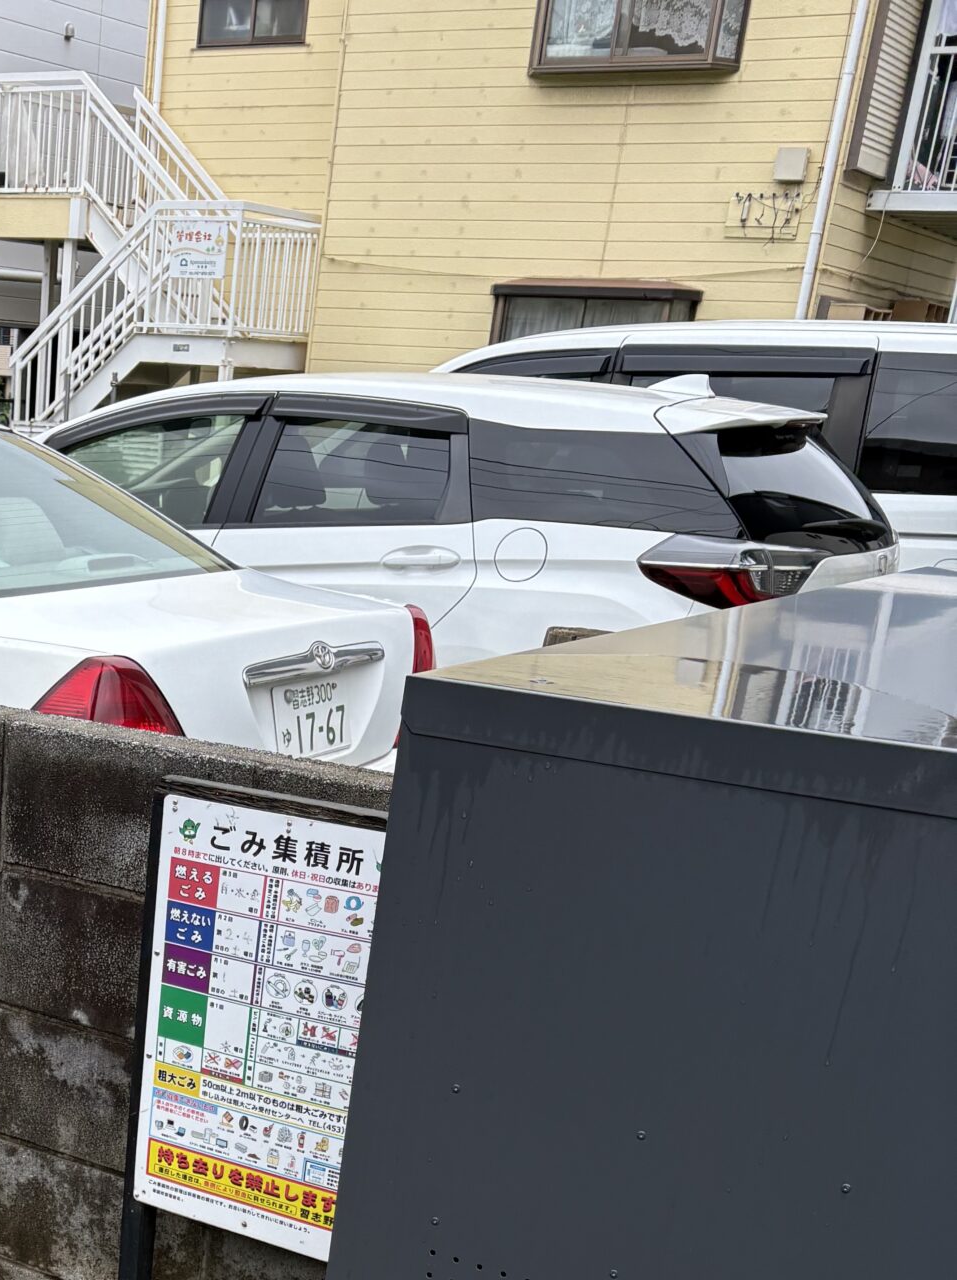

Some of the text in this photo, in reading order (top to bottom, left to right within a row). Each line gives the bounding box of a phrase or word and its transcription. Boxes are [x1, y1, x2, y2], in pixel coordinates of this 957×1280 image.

[314, 682, 333, 703] 300
[297, 704, 345, 754] 17-67
[211, 826, 363, 874] ごみ集積所
[175, 864, 212, 883] 燃える
[179, 885, 205, 899] ごみ
[170, 908, 210, 926] 燃えない
[176, 928, 202, 943] ごみ
[166, 958, 206, 978] 有害ごみ
[163, 1005, 202, 1026] 資源物
[157, 1069, 195, 1089] 粗大ごみ
[158, 1148, 335, 1212] 持ち去りを禁止します
